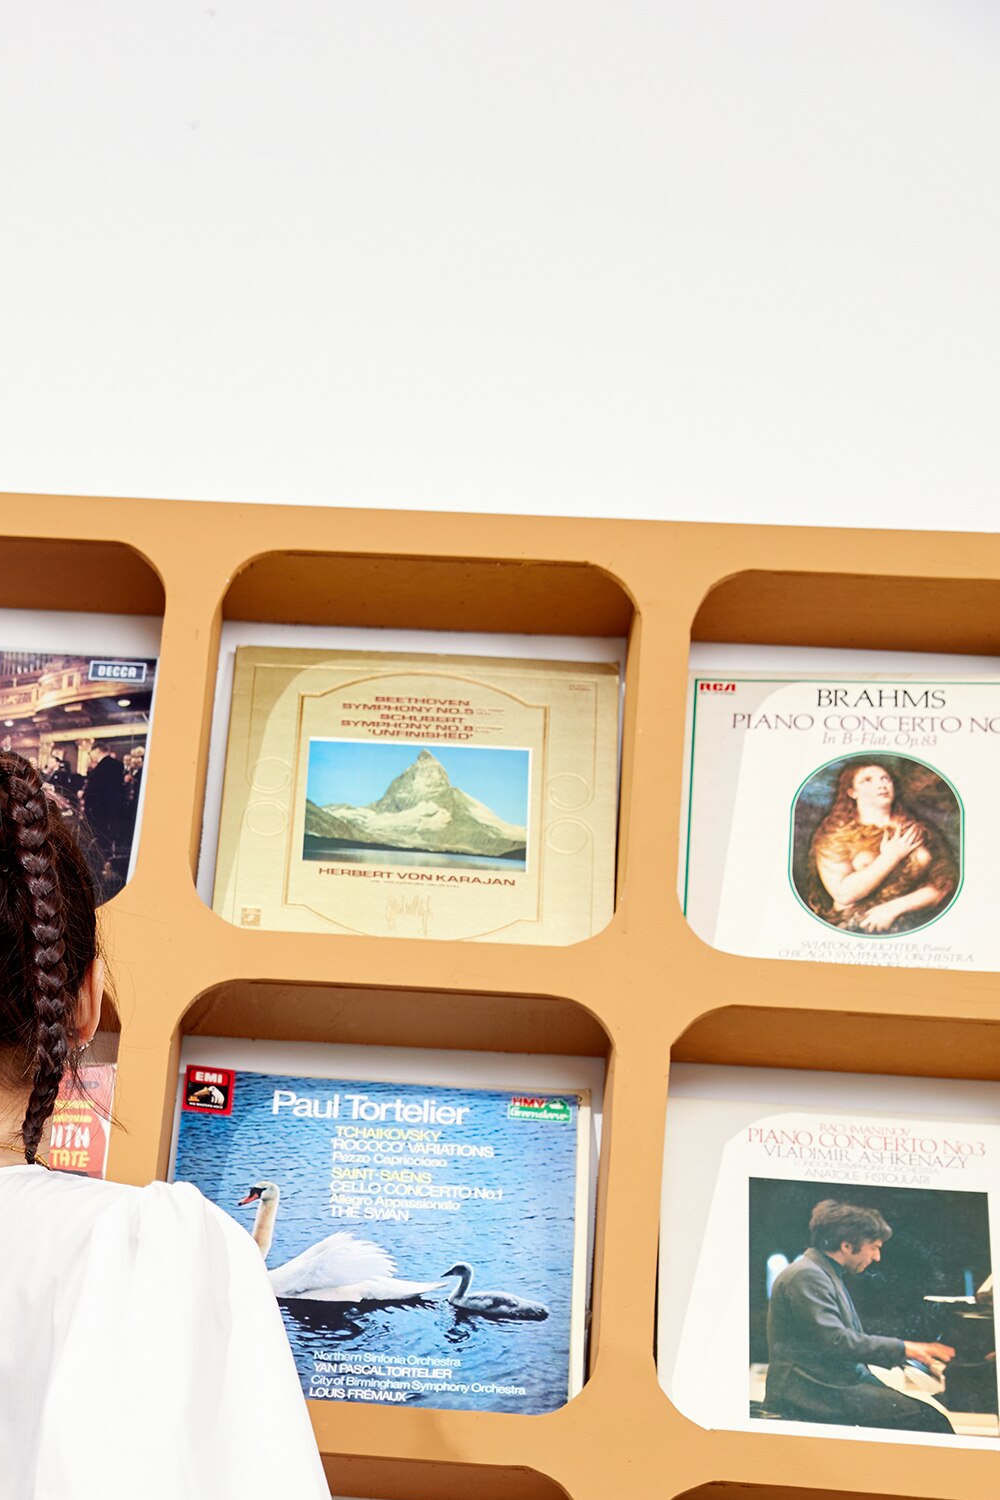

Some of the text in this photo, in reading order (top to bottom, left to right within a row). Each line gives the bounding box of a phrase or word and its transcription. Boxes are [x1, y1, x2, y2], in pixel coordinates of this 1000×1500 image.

[97, 665, 137, 679] DECCA
[699, 682, 736, 692] RCA
[342, 702, 433, 713] SYMPHONY
[375, 695, 470, 707] BEETHOVEN
[816, 688, 947, 710] BRAHMS
[341, 719, 432, 730] SYMPHONY
[380, 713, 466, 724] SCHUBERT
[731, 713, 815, 731] PIANO
[823, 714, 963, 734] CONCERTO
[318, 867, 393, 880] HERBERT
[397, 872, 433, 881] VON
[436, 875, 516, 887] KARAJAN
[195, 1071, 223, 1084] EMI
[271, 1090, 470, 1126] Paul Tortelier
[511, 1095, 546, 1109] HMV
[335, 1125, 443, 1142] TCHAIKOVSKY
[747, 1127, 814, 1145] PIANO
[818, 1131, 938, 1154] CONCERTO
[50, 1149, 91, 1168] TATE
[408, 1142, 495, 1158] VARIATIONS
[763, 1143, 969, 1170] VLADIMIR ASHKENAZY
[331, 1151, 448, 1168] Pezzo Capriccioso
[329, 1180, 382, 1195] CELLO
[383, 1183, 472, 1199] CONCERTO
[329, 1193, 461, 1211] Allegro Appassionato
[329, 1205, 410, 1222] THE SWAN
[313, 1351, 462, 1368] Northern Sinfonia Orchestra
[313, 1363, 453, 1379] YAN PASCAL TORTELIER
[310, 1374, 526, 1396] City of Birmingham Symphony Orchestra
[309, 1386, 408, 1402] LOUIS FRÉMAUX
